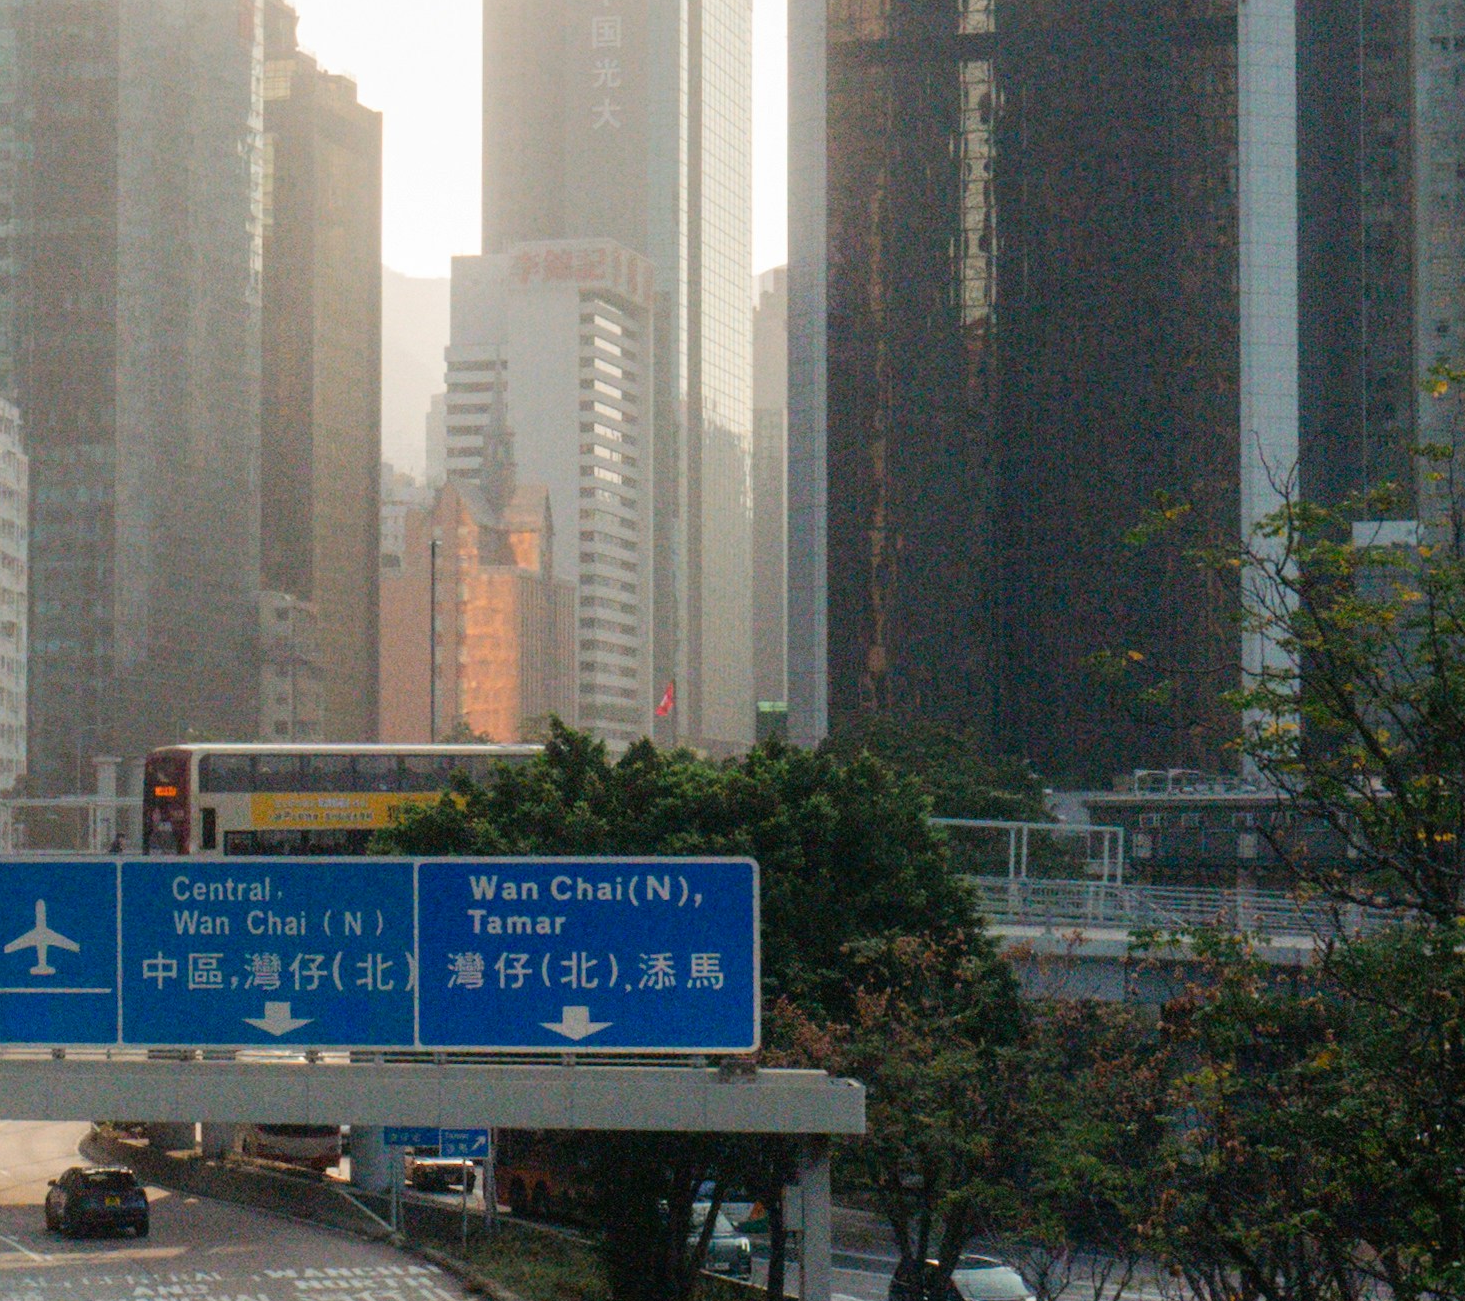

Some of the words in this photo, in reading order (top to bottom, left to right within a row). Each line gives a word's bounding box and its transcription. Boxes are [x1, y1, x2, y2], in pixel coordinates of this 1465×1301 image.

[470, 875, 540, 901] Wan
[173, 911, 231, 936] Wan
[246, 910, 307, 936] Chai
[467, 910, 567, 936] Tamar
